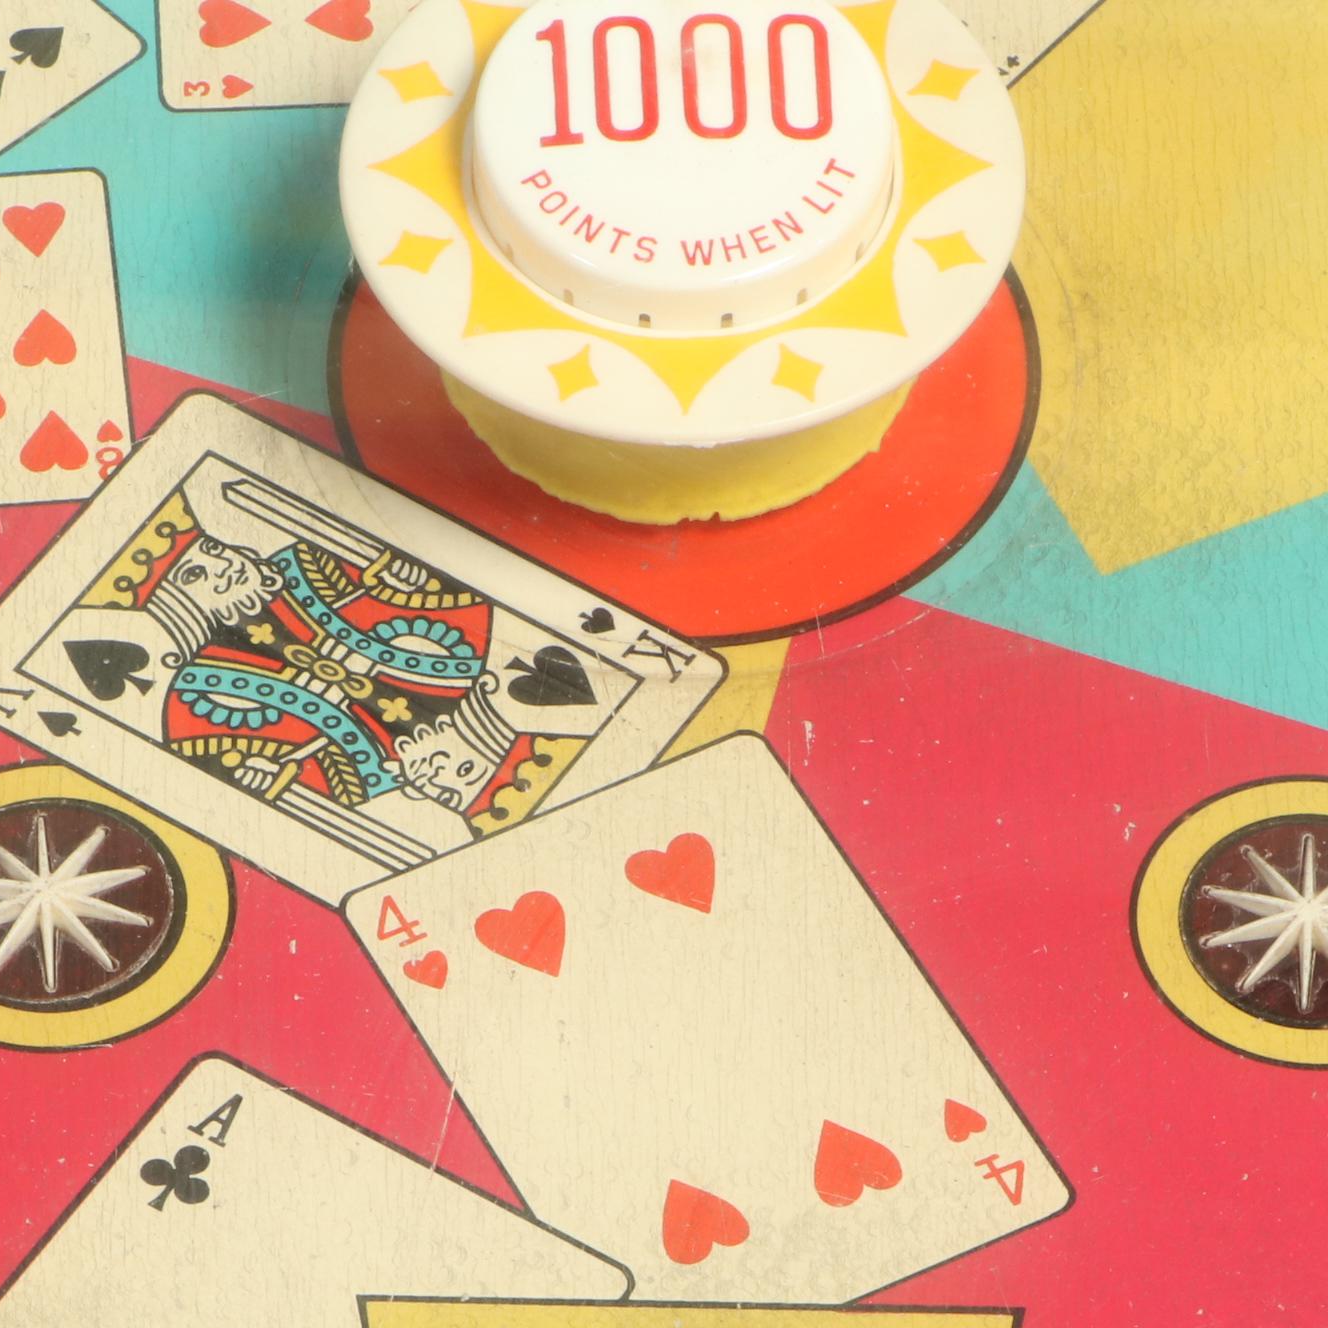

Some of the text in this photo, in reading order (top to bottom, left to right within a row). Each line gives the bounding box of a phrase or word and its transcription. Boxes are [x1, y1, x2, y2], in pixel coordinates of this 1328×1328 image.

[183, 81, 211, 98] 3
[536, 14, 833, 147] 1000
[521, 157, 858, 267] POINTS WHEN LIT
[621, 628, 697, 685] K
[376, 894, 428, 948] 4
[187, 1093, 244, 1147] A
[974, 1153, 1026, 1206] 4
